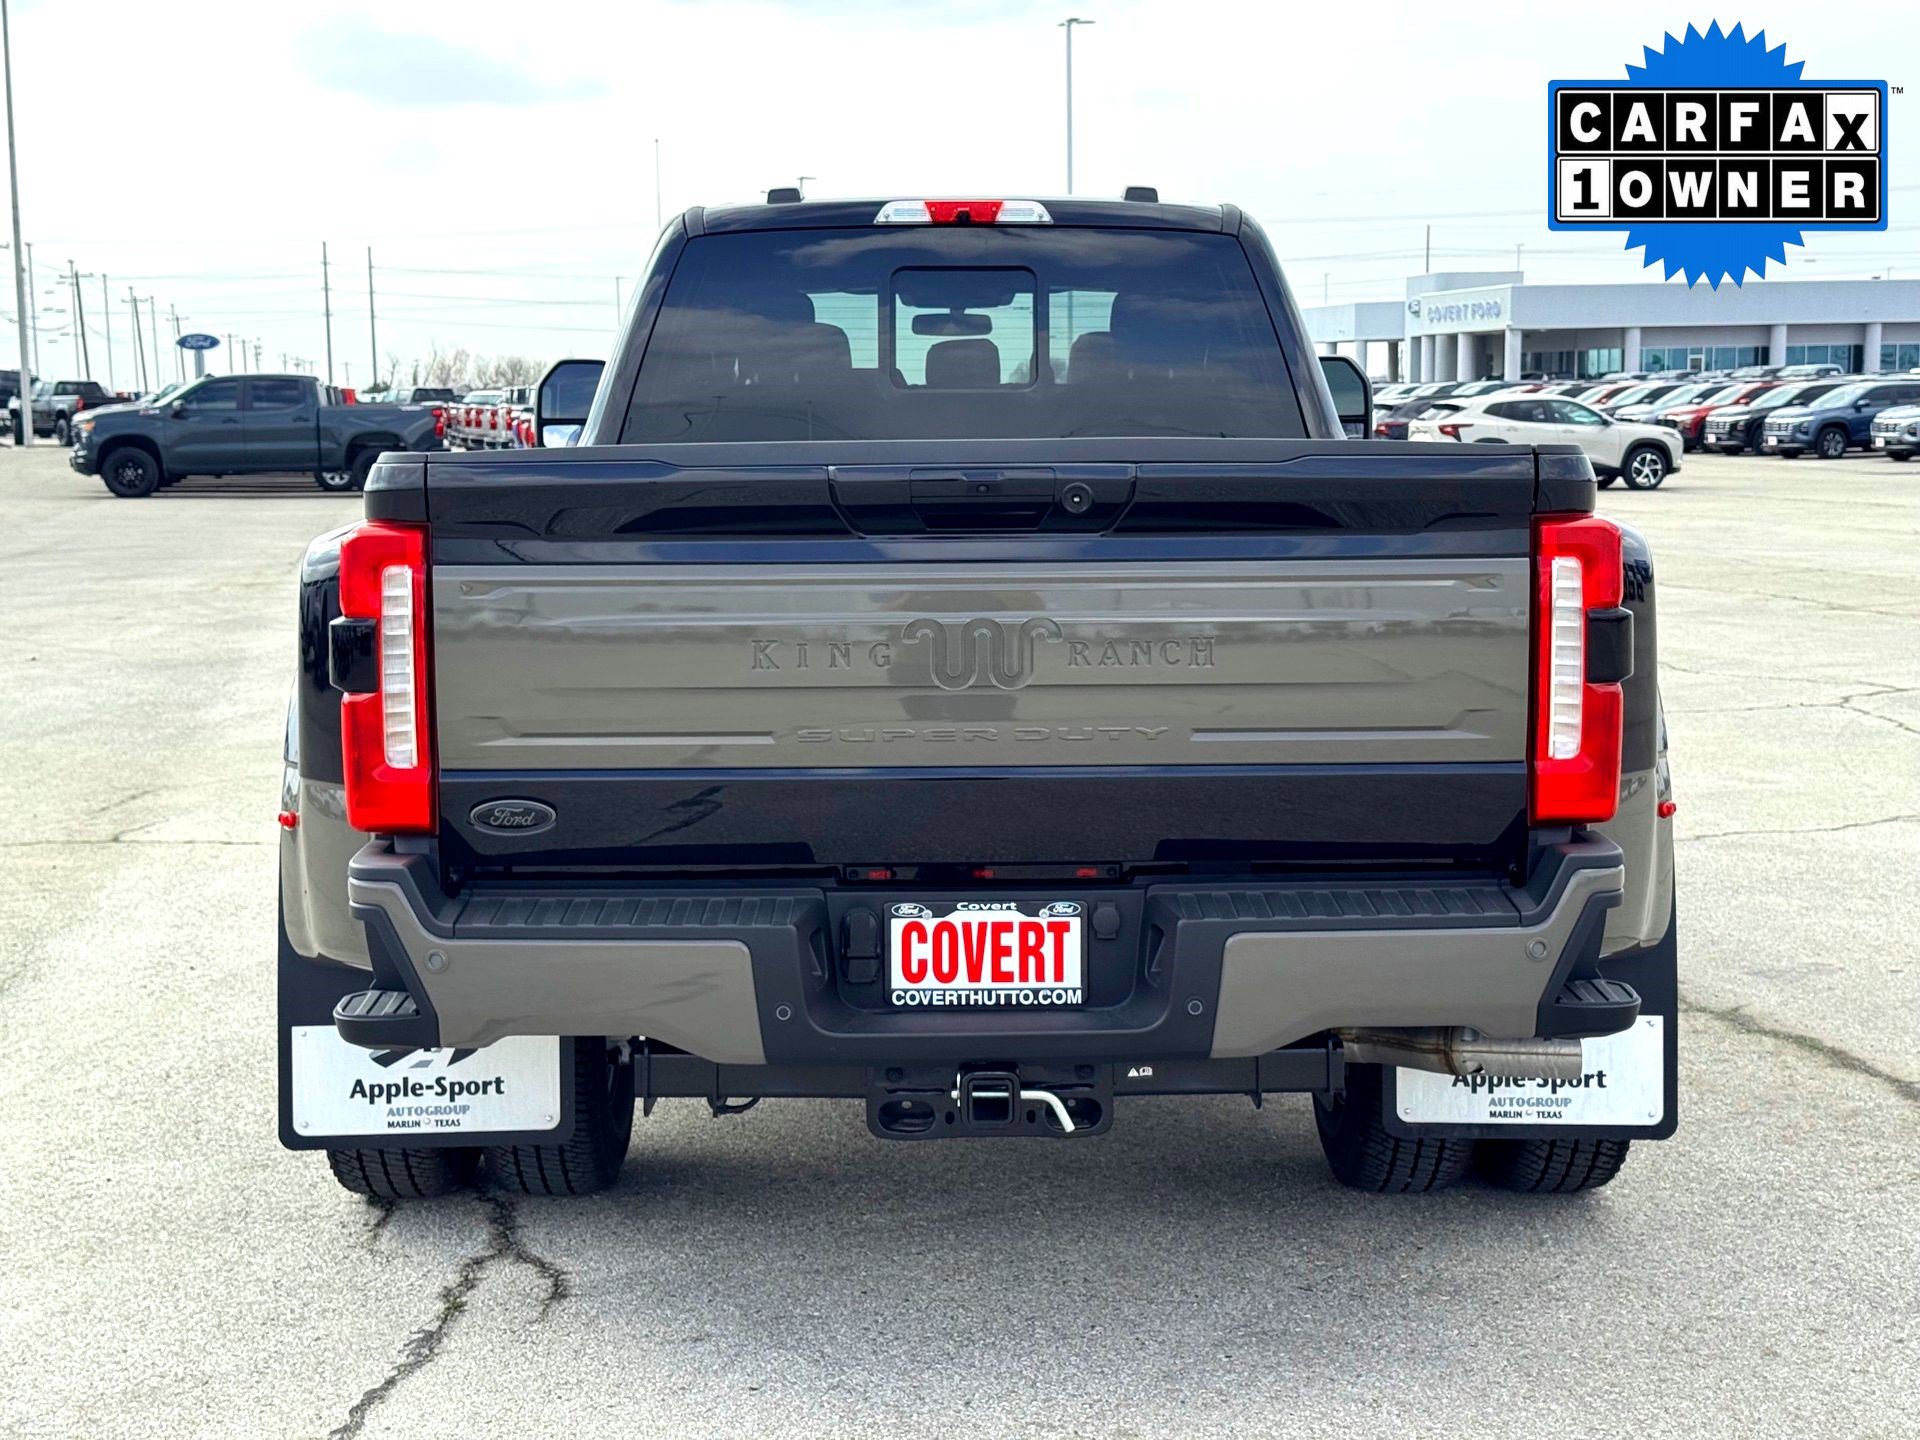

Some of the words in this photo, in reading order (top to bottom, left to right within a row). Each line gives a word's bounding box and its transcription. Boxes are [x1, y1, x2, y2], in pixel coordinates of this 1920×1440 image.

[1428, 304, 1469, 323] COVERT
[751, 639, 892, 671] KING
[1067, 636, 1216, 668] RANCH
[797, 727, 1000, 743] SUPER
[1014, 726, 1169, 741] DUTY
[490, 807, 536, 826] Ford
[898, 904, 920, 914] Ford
[956, 902, 1017, 911] Covert
[1052, 903, 1075, 914] Ford
[901, 920, 1070, 984] COVERT
[892, 989, 1082, 1006] COVERTHUTTO.COM
[350, 1076, 505, 1104] Apple-Sport
[1488, 1096, 1572, 1108] AUTOGROUP
[387, 1104, 471, 1117] AUTOGROUP
[1489, 1109, 1522, 1119] MARLIN
[1537, 1109, 1562, 1119] TEXAS
[387, 1119, 421, 1129] MARLIN
[434, 1118, 461, 1128] TEXAS
